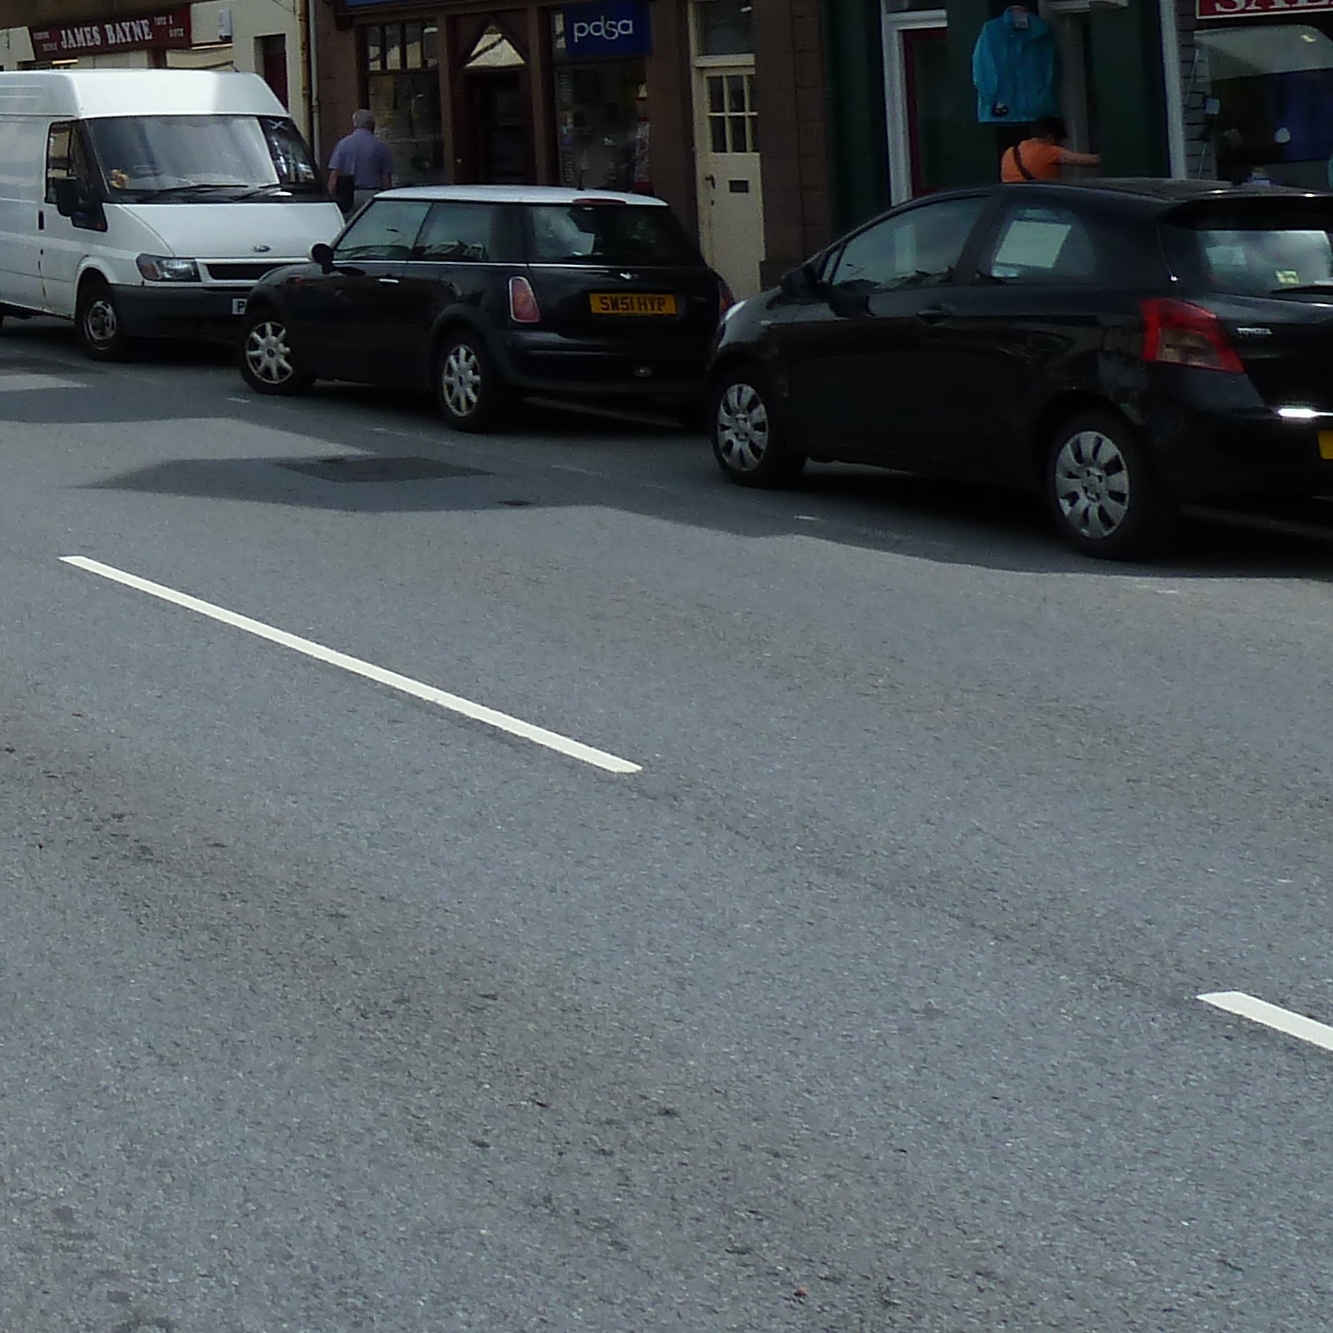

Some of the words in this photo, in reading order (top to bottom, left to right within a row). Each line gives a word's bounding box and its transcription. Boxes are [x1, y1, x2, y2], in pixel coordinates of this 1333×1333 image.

[60, 26, 101, 49] JAMES
[104, 19, 153, 45] BAYNE
[573, 15, 633, 43] pdsa
[636, 296, 667, 312] HYP
[1237, 326, 1272, 335] TOYOTA
